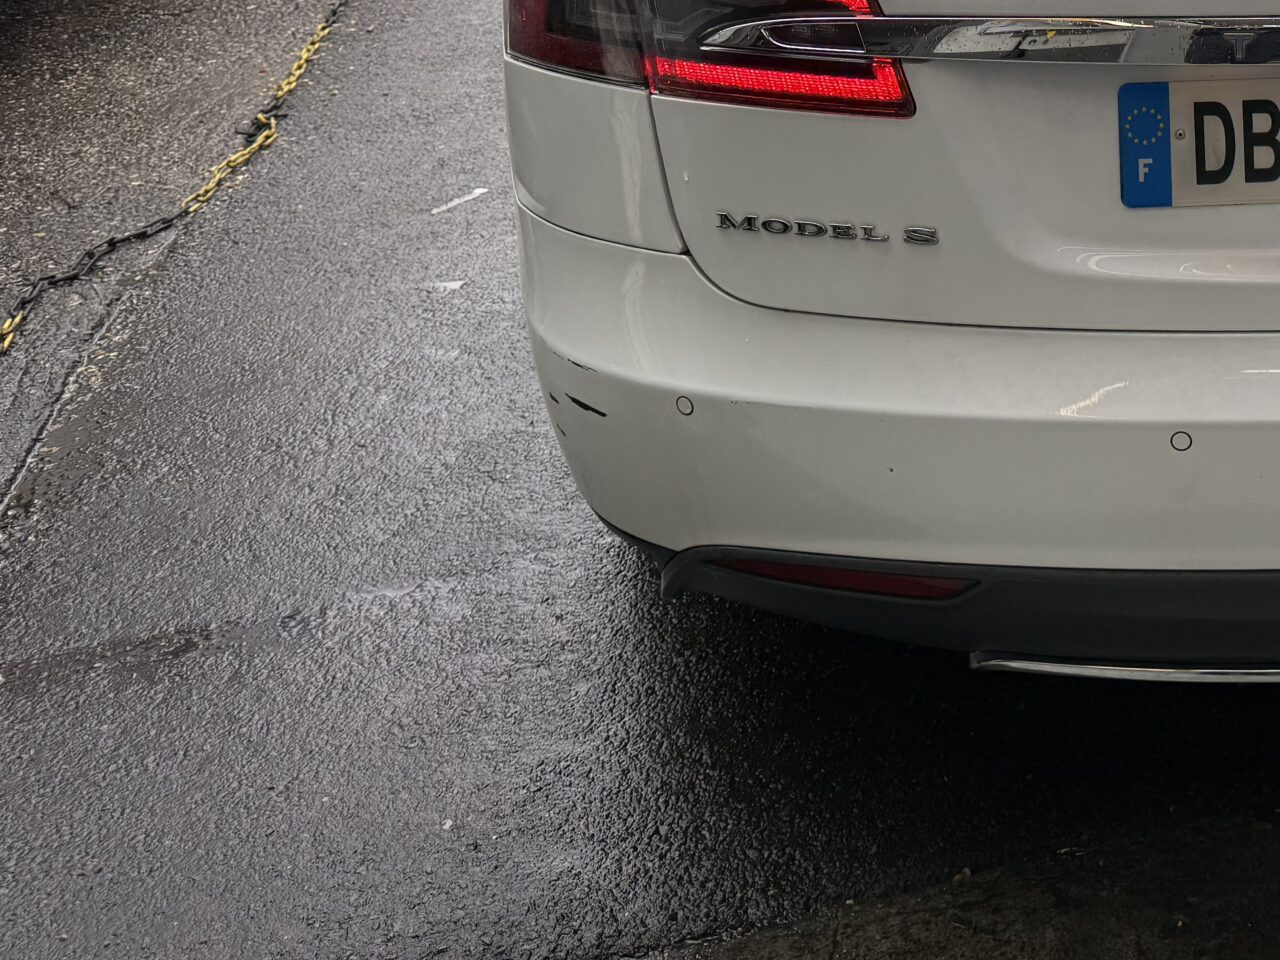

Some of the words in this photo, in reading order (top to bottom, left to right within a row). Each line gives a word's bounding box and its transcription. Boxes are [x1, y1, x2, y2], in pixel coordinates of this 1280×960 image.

[1138, 158, 1153, 182] F
[715, 211, 890, 242] MODEL
[903, 226, 939, 246] S
